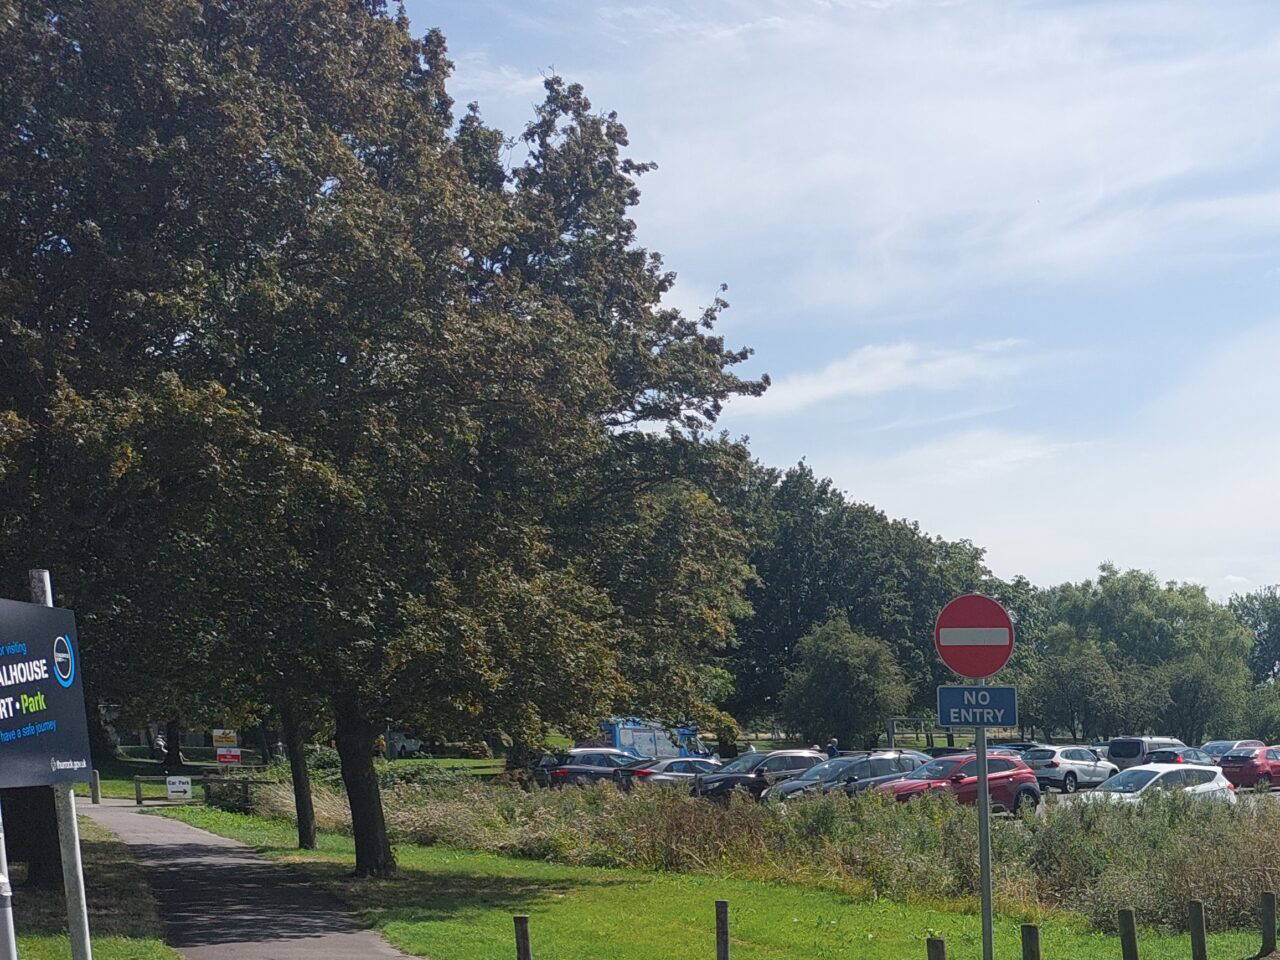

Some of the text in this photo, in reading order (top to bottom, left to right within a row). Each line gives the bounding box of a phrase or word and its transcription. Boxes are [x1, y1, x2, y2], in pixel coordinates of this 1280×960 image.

[20, 691, 47, 714] Park
[963, 690, 991, 705] NO
[949, 708, 1005, 723] ENTRY
[22, 723, 35, 737] safe
[35, 719, 56, 737] journey
